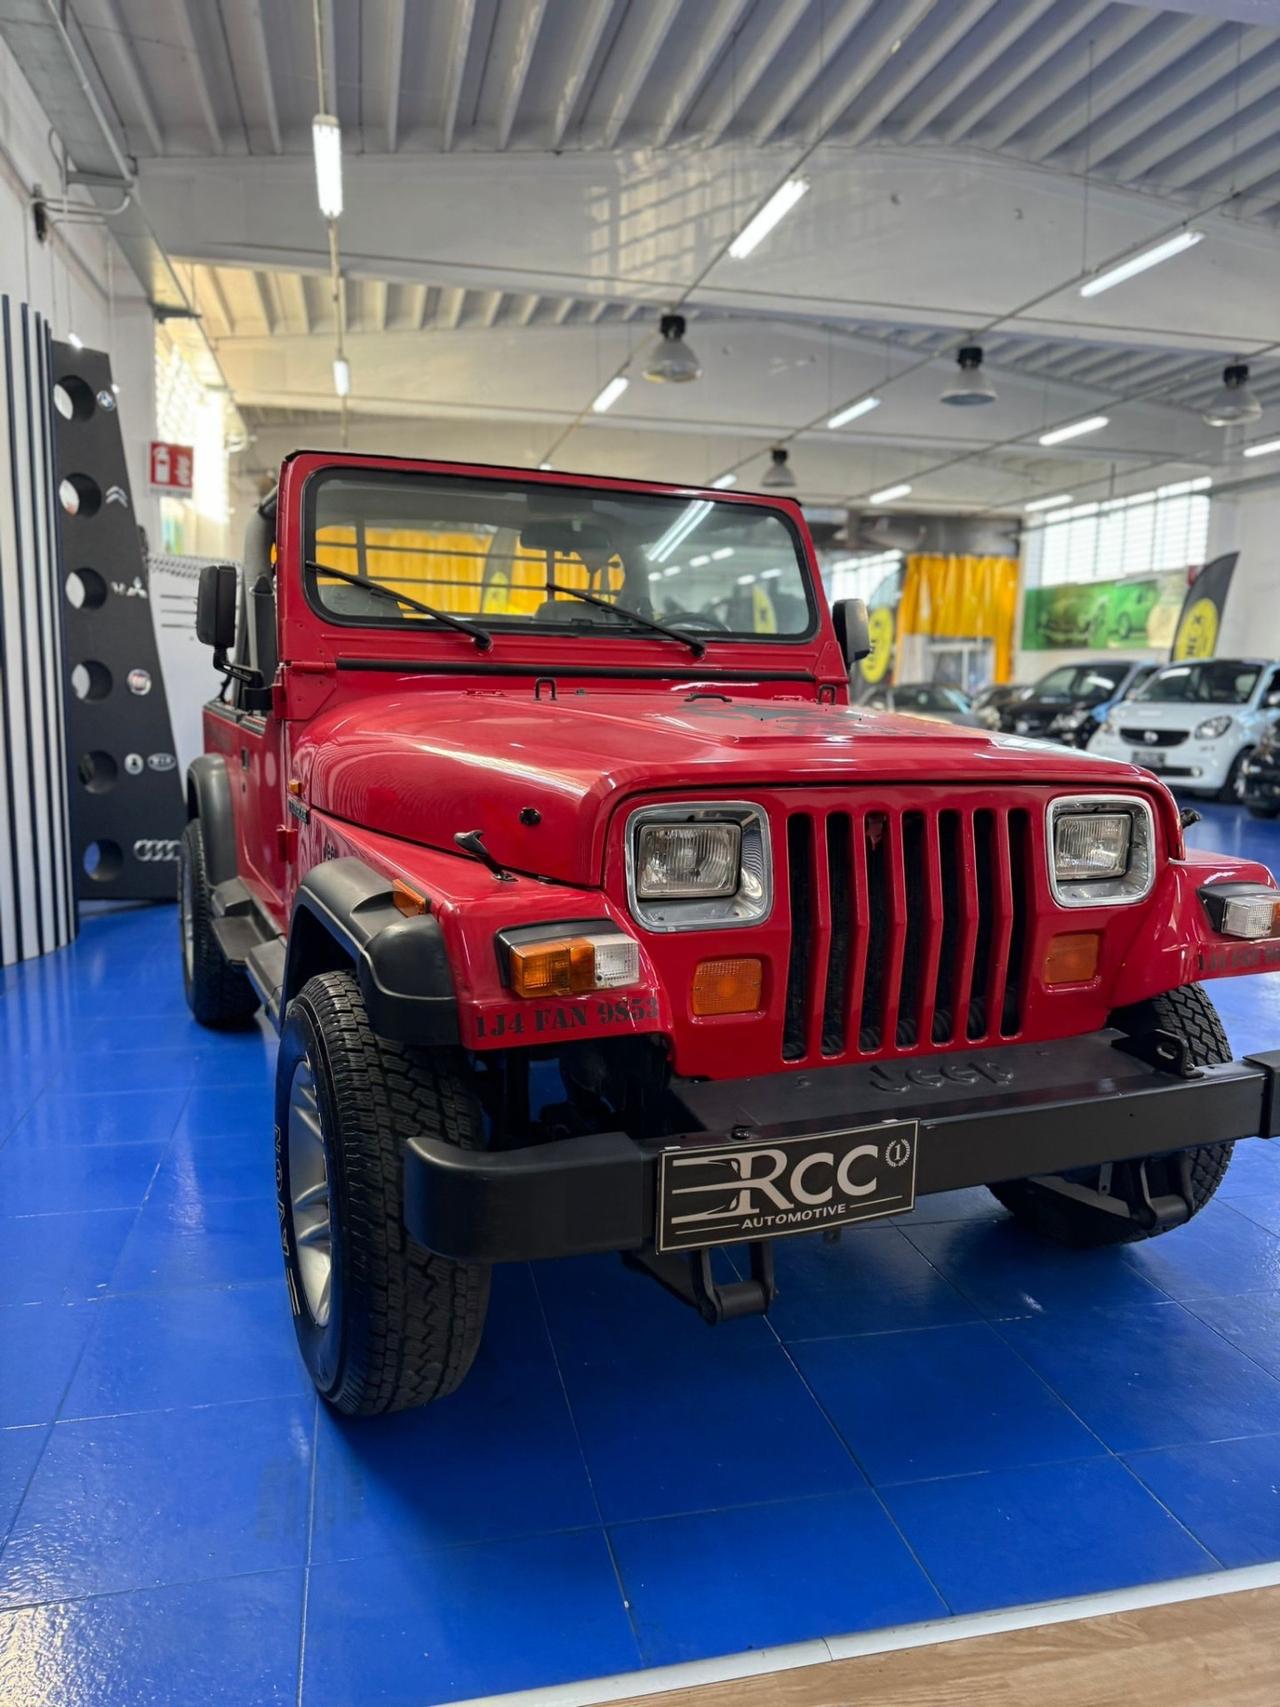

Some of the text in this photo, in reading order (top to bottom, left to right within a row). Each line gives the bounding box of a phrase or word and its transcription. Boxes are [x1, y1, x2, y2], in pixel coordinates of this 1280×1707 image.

[476, 1012, 524, 1038] 1J4
[534, 1006, 587, 1032] FAN
[869, 1062, 1013, 1094] Jeep
[741, 1204, 846, 1230] AUTOMOTIVE
